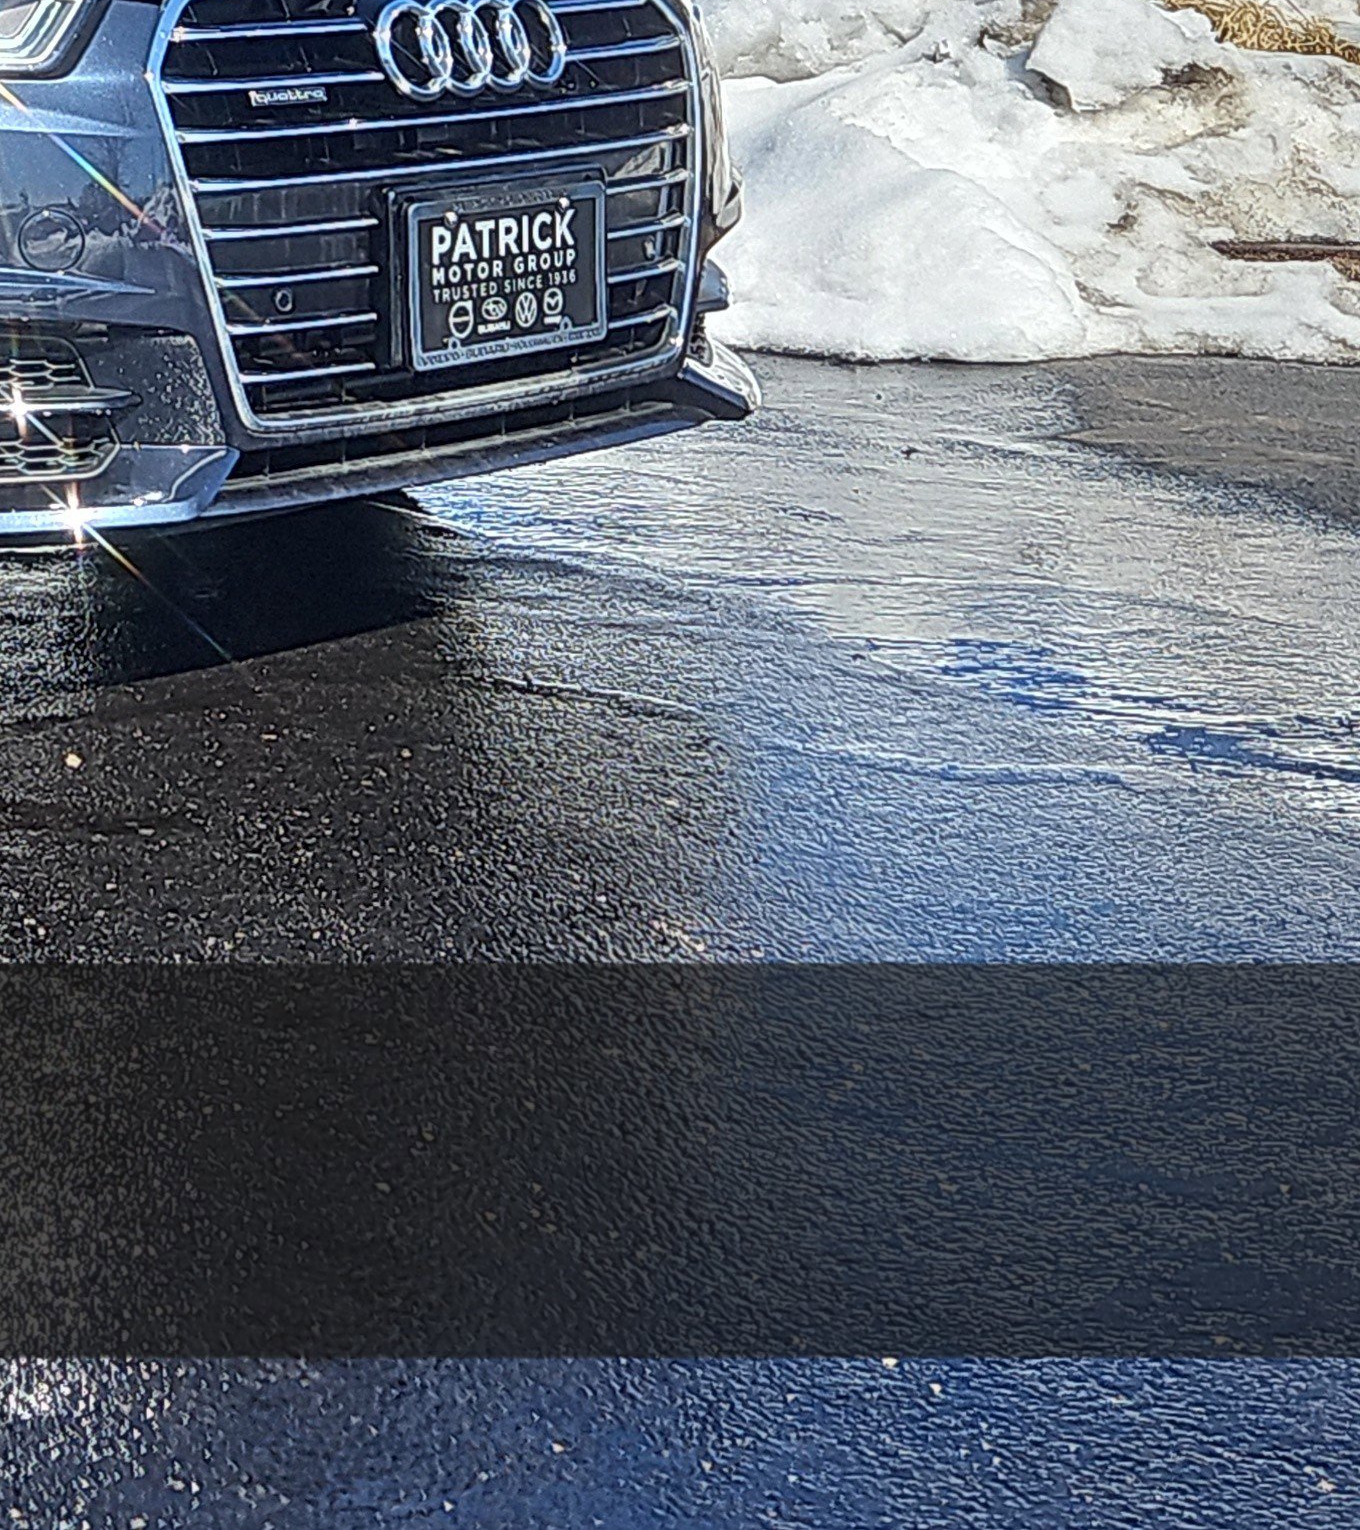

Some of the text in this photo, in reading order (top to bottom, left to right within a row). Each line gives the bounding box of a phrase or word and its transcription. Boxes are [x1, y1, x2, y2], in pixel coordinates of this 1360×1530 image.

[255, 88, 325, 106] quattro
[431, 208, 577, 266] PATRICK
[432, 248, 577, 287] MOTOR GROUP
[433, 281, 498, 304] TRUSTED
[503, 274, 544, 294] SINCE
